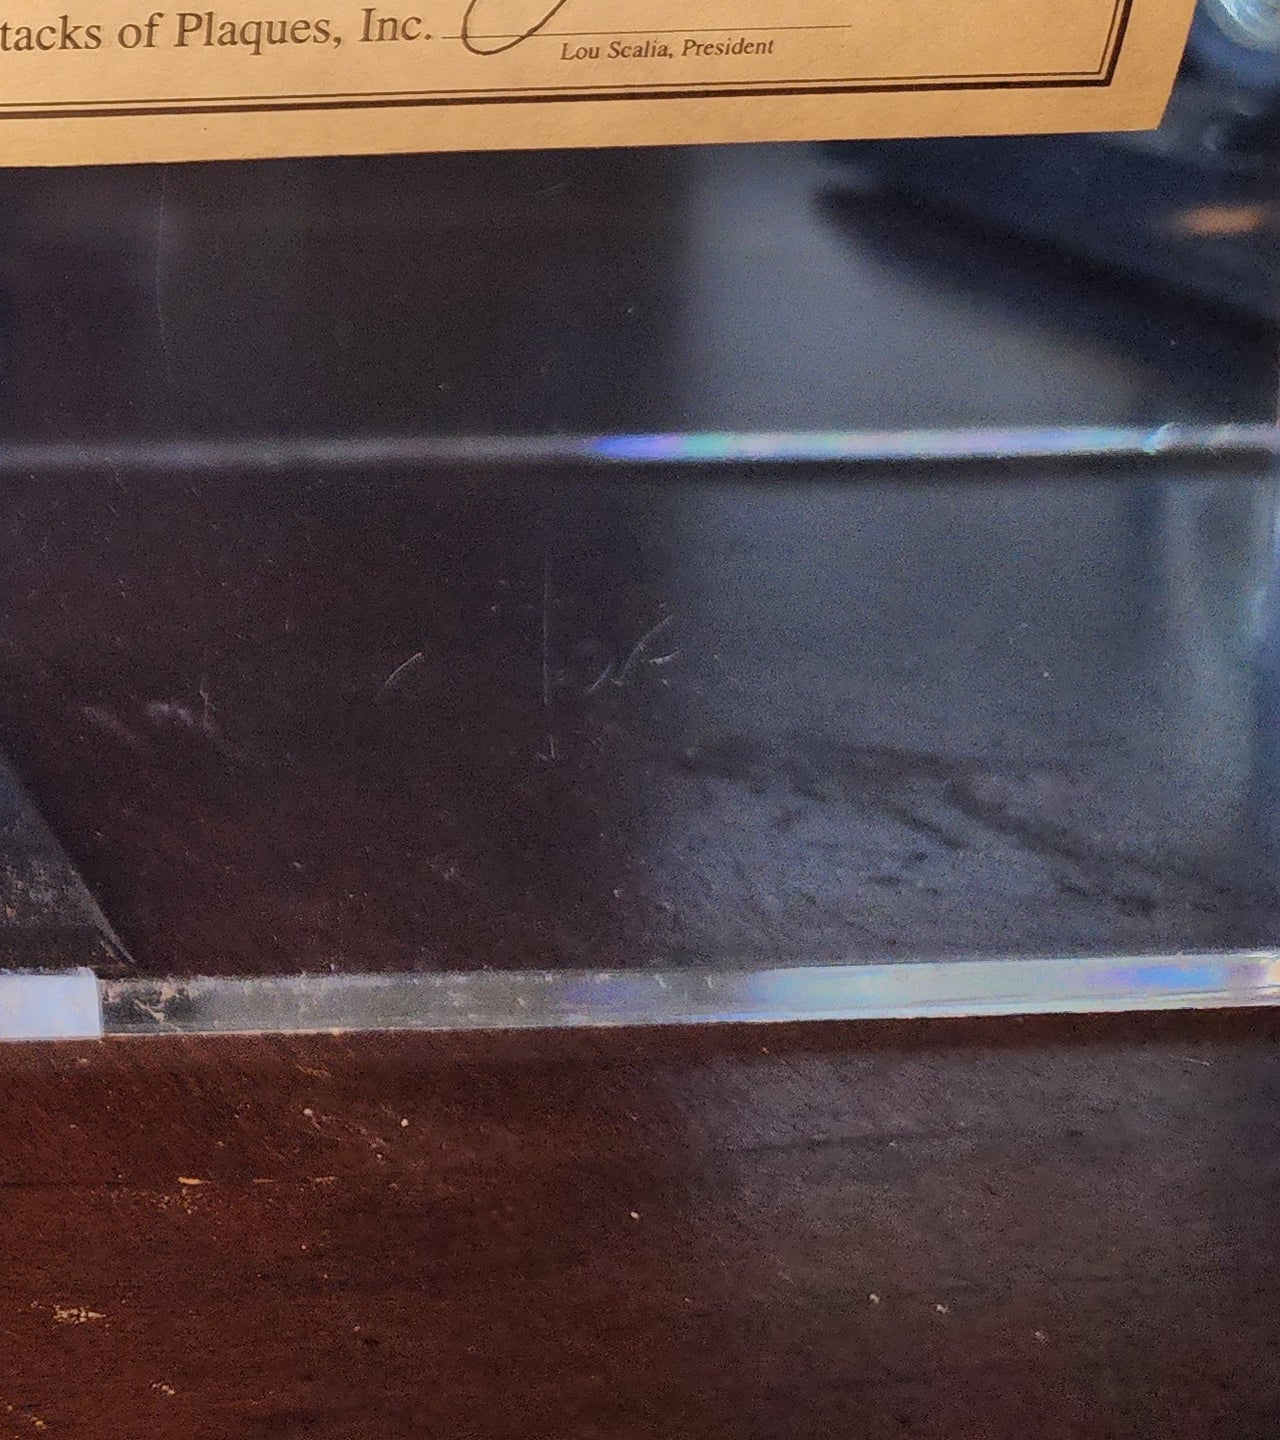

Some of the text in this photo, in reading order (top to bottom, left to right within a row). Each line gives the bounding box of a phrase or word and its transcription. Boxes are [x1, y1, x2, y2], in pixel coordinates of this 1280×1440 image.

[117, 12, 165, 49] of
[173, 11, 342, 56] Plaques,
[359, 7, 432, 43] Inc.
[560, 37, 774, 61] Lou Scalia, President
